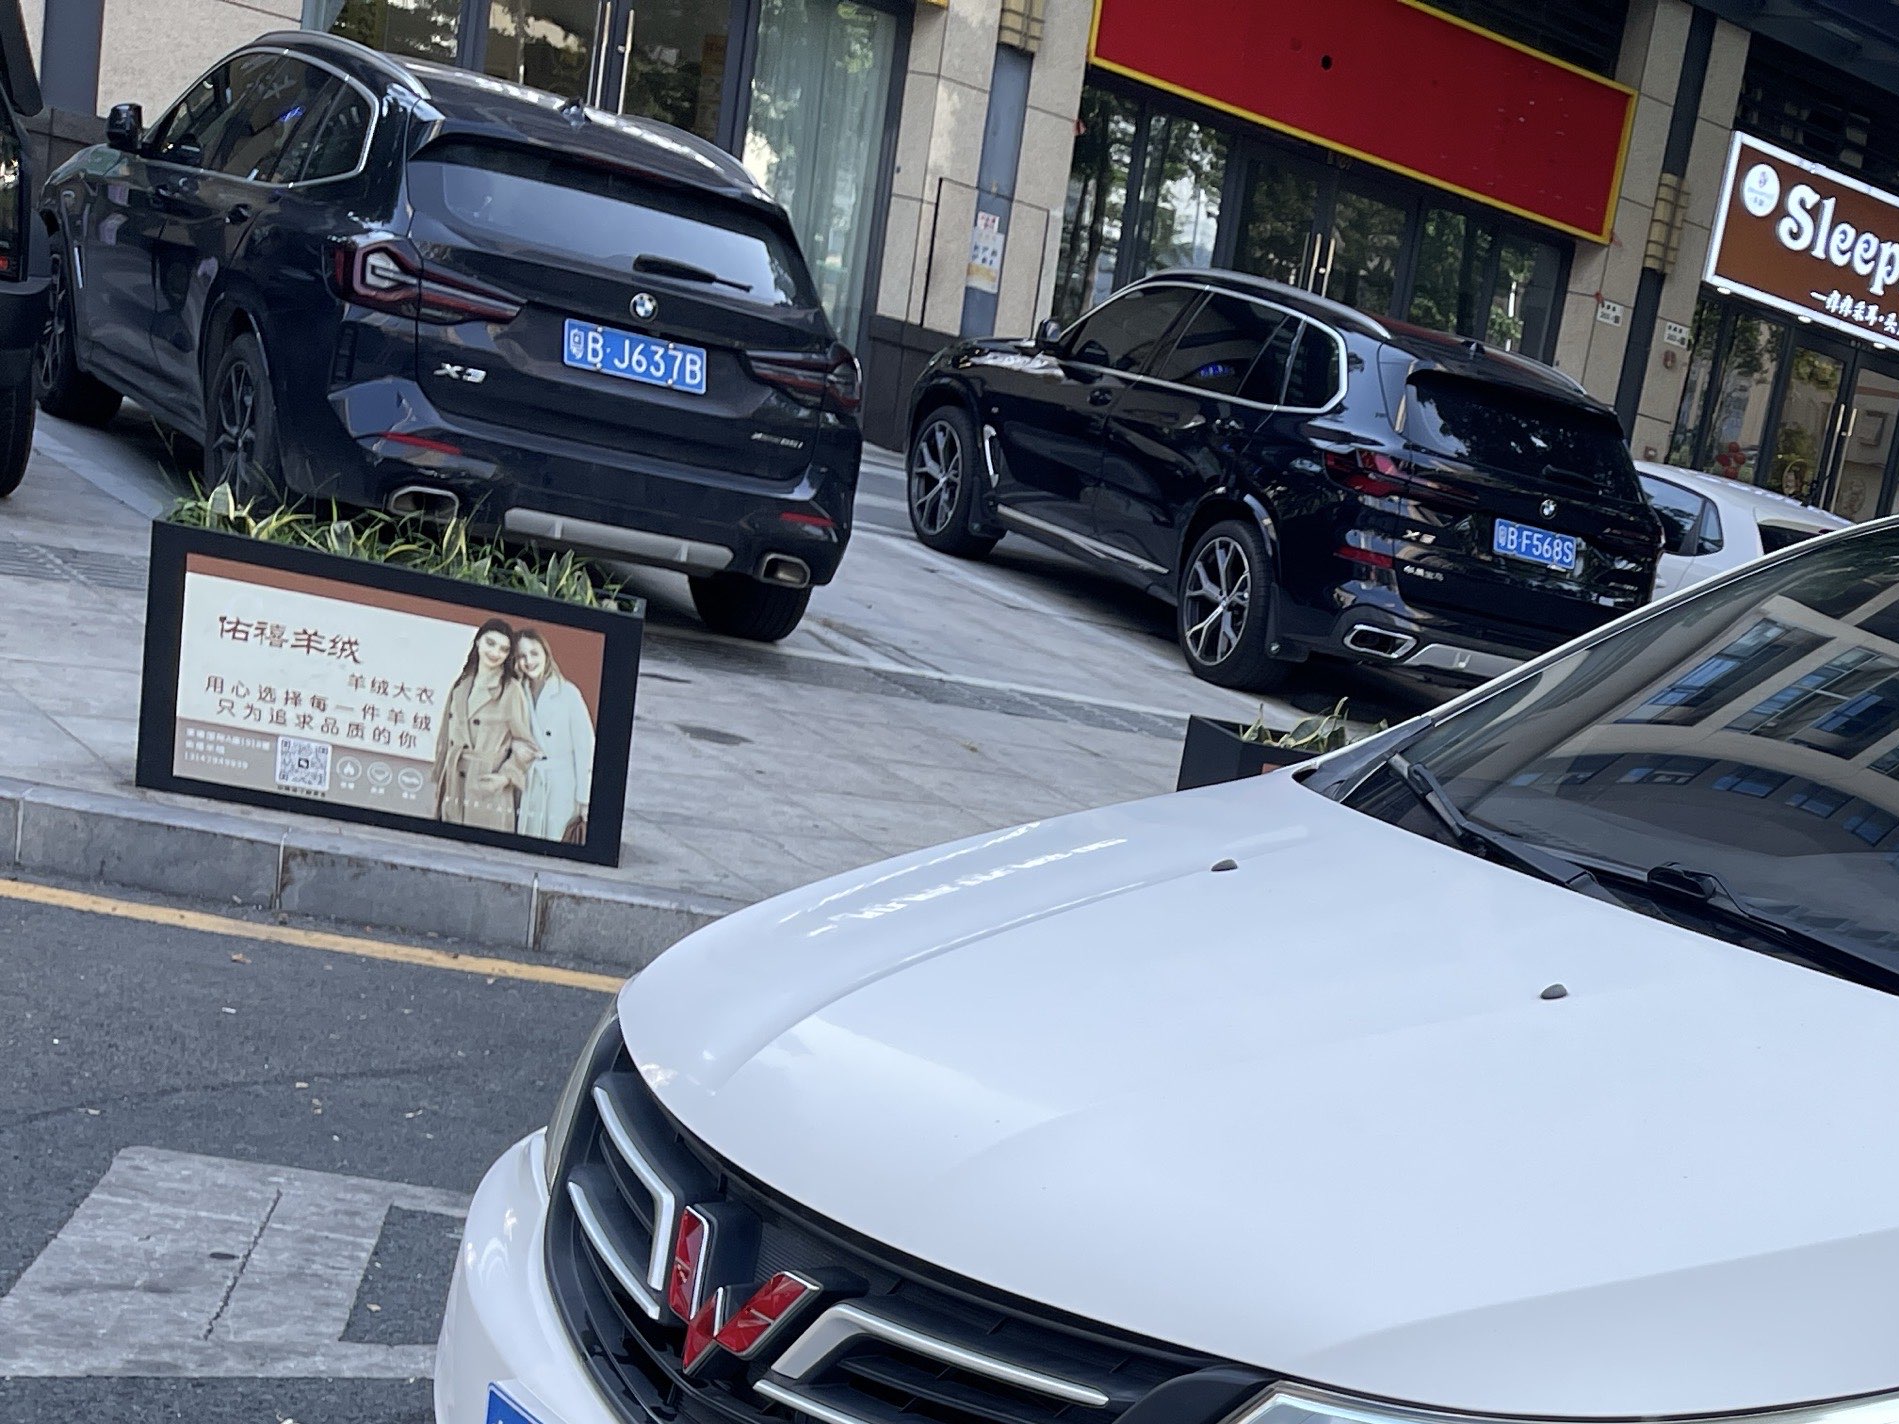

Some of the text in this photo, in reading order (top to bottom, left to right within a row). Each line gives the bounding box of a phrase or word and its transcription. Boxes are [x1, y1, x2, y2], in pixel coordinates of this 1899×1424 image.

[219, 616, 361, 664] 佑禧羊绒
[205, 675, 431, 731] 用心选择每一件羊绒
[348, 673, 434, 704] 羊绒大衣
[217, 699, 417, 748] 只为追求品质的你
